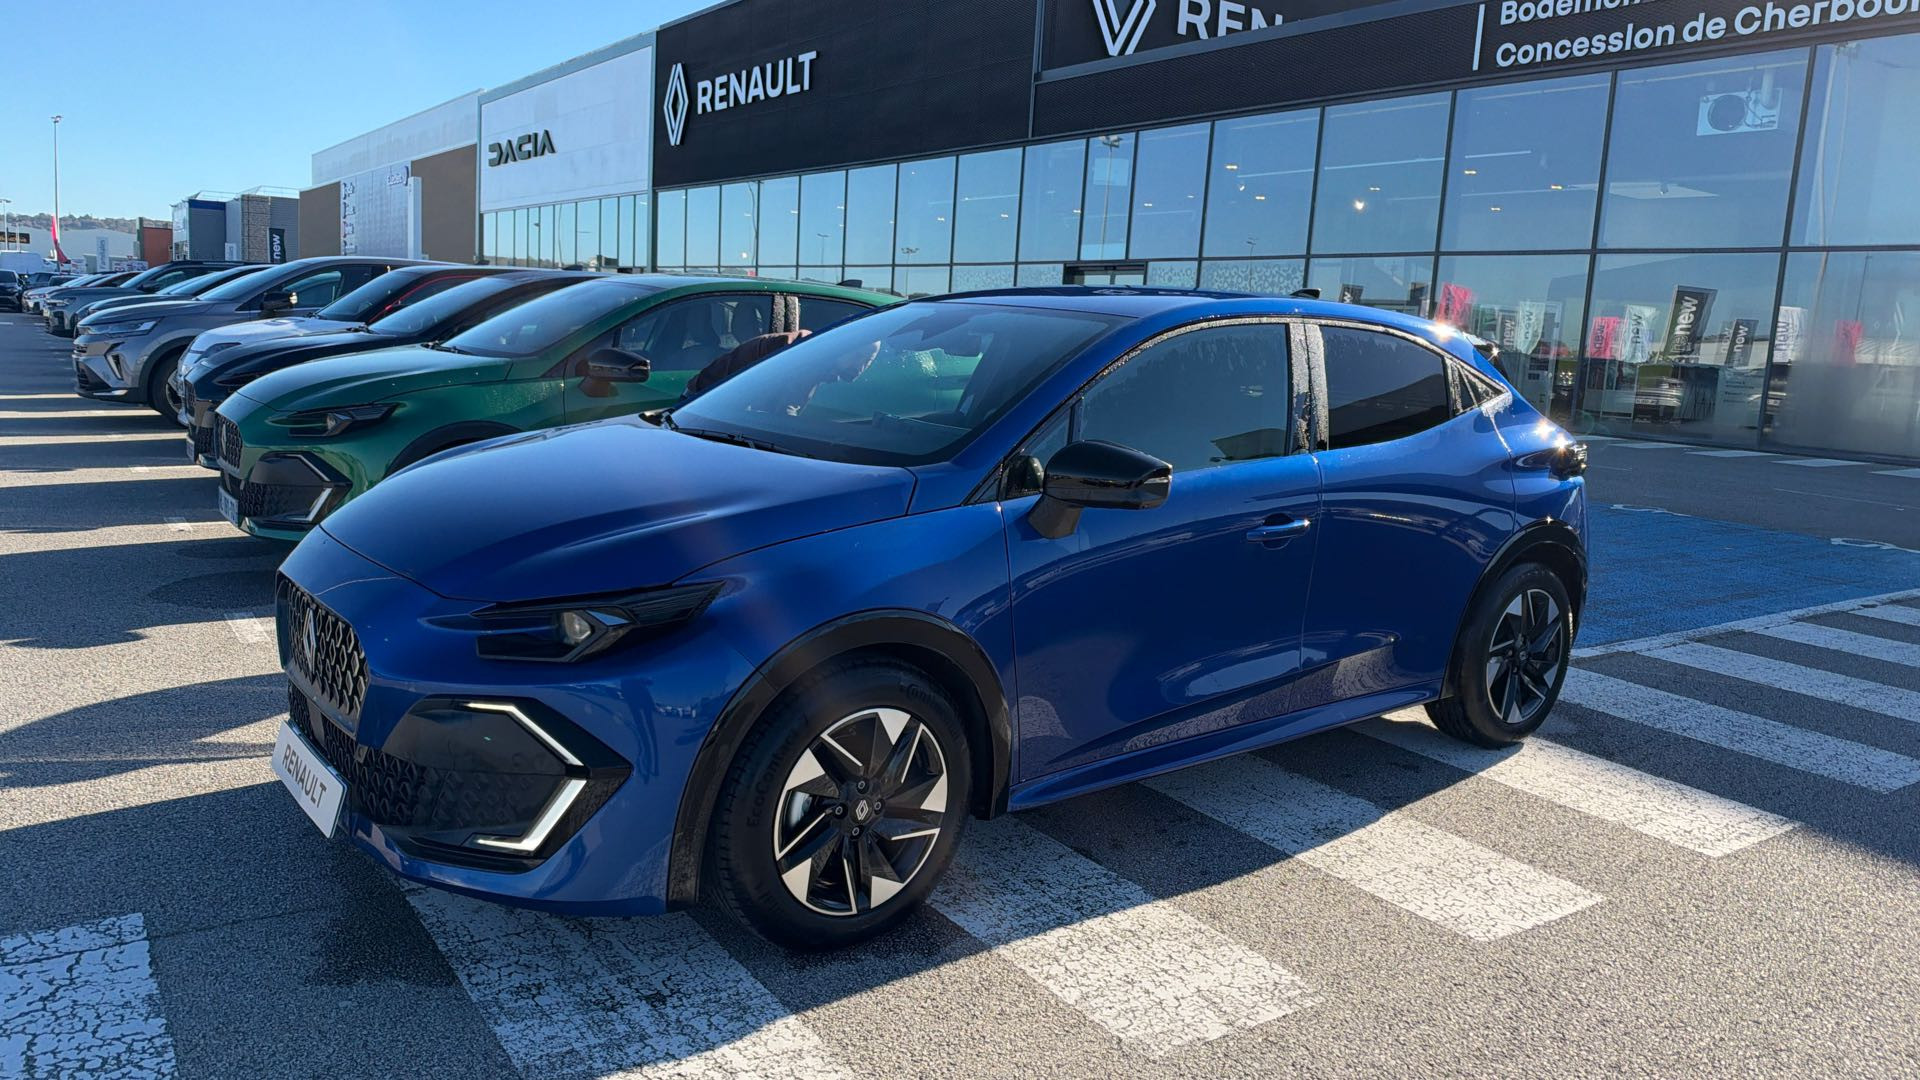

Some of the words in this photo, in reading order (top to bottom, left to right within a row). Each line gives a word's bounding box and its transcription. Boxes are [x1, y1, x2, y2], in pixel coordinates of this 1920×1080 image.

[1496, 23, 1675, 67] Concession
[1683, 13, 1726, 42] de
[697, 51, 817, 114] RENAULT
[488, 129, 556, 167] DACIA
[272, 233, 281, 259] new
[1733, 325, 1748, 352] new
[282, 743, 327, 809] RENAULT
